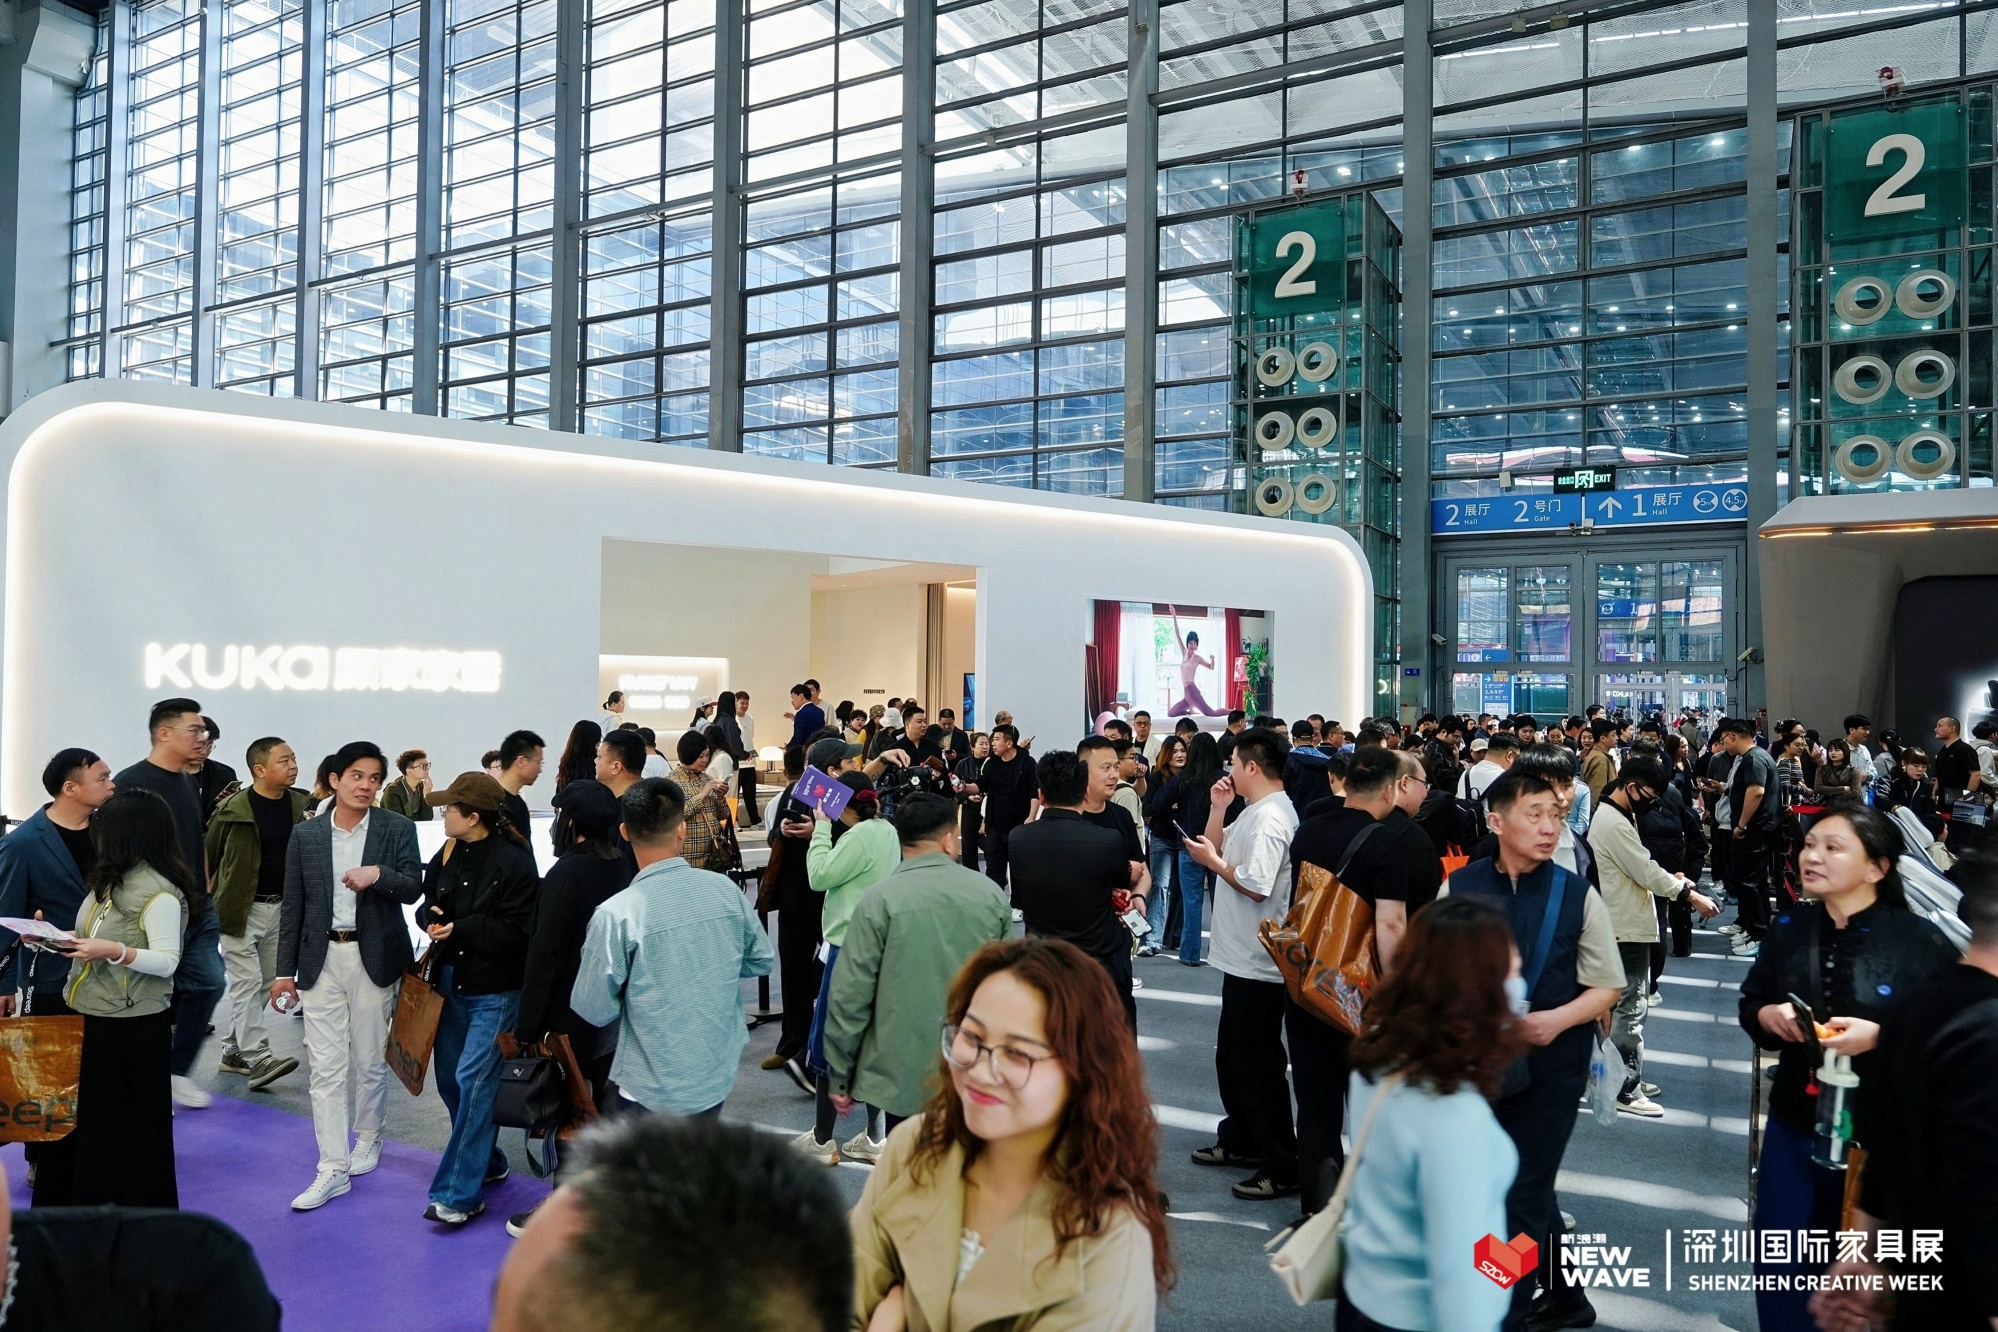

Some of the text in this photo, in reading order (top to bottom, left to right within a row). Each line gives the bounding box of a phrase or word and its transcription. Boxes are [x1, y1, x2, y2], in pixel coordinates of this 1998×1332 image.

[1864, 133, 1925, 217] 2
[1275, 230, 1316, 298] 2
[1594, 473, 1612, 483] EXIT
[1445, 503, 1490, 526] 2 展厅
[1513, 499, 1561, 523] 2 号门
[1632, 492, 1683, 517] 1 展厅
